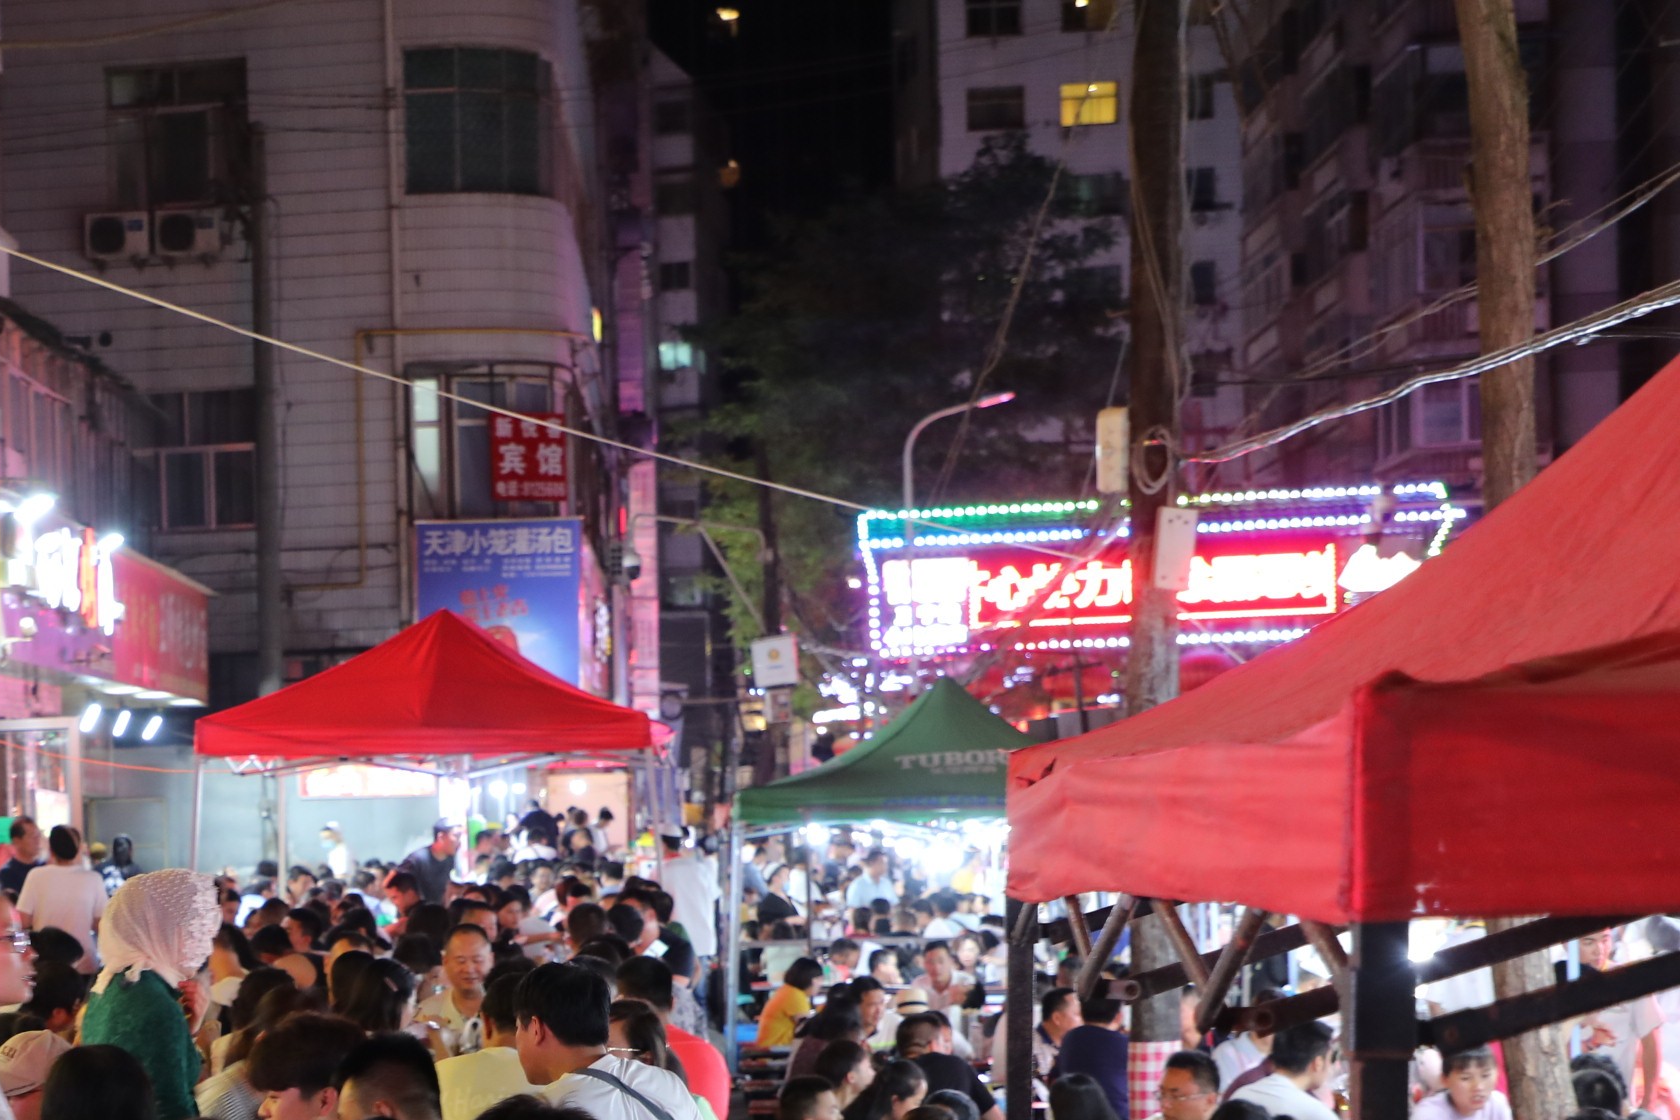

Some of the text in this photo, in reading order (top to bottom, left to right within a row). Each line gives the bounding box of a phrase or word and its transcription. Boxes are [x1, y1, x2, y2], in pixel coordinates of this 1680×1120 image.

[498, 442, 563, 475] 宾馆
[423, 527, 575, 555] 天津小笼灌汤包
